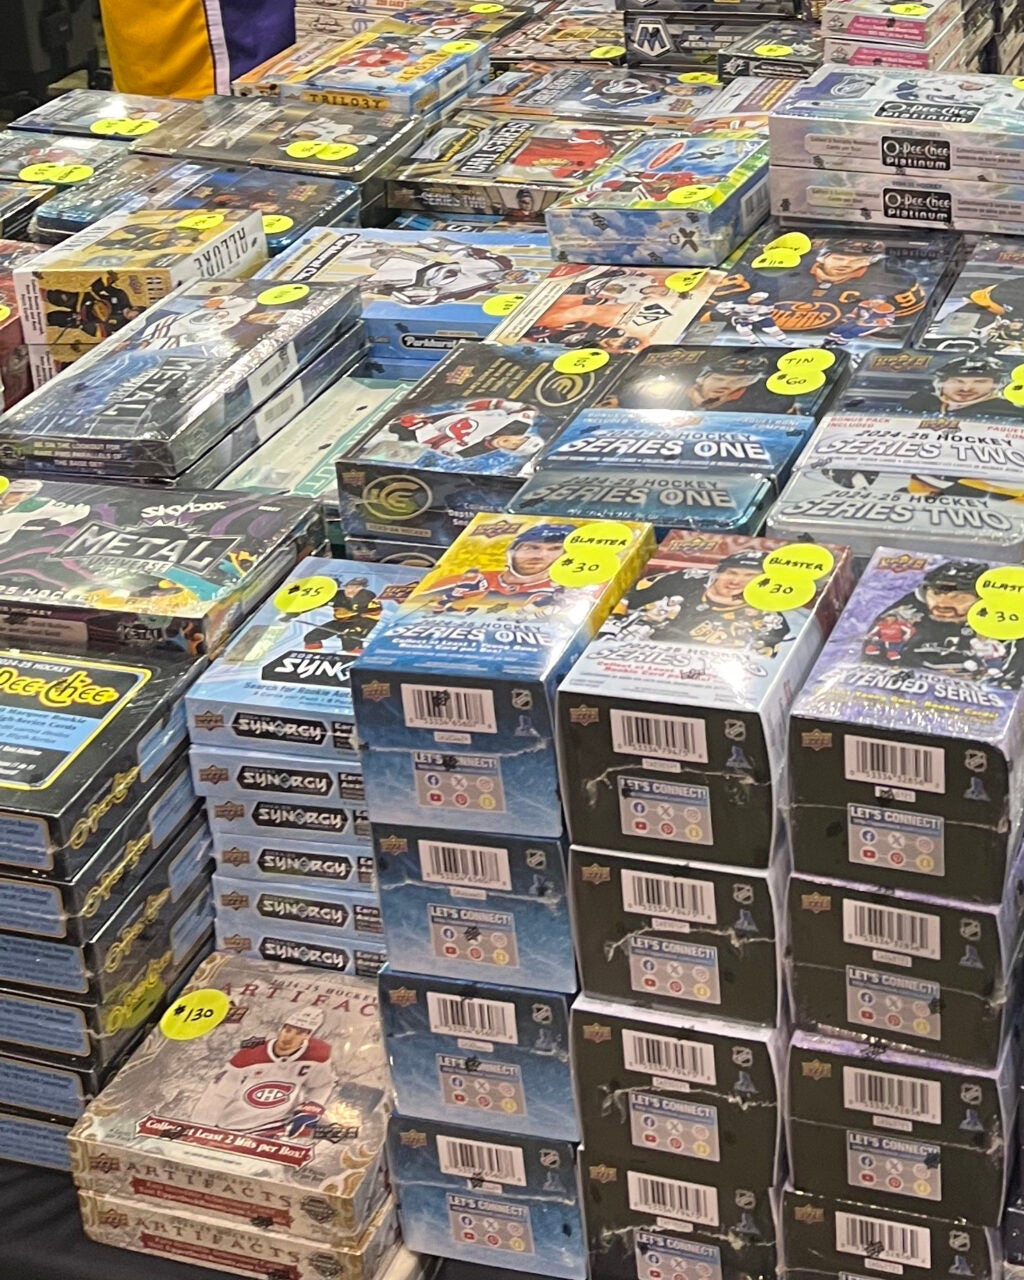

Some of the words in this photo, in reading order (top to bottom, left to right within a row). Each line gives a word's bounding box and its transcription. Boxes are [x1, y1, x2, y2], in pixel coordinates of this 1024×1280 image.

[883, 139, 950, 158] O-Pee-Chee
[885, 158, 947, 169] Platinum
[885, 191, 951, 210] O-Pee-Chee
[888, 208, 948, 220] Platinum
[785, 355, 815, 366] TIN
[777, 373, 807, 386] $60
[856, 429, 930, 442] 2024-25
[937, 433, 1014, 447] HOCKEY
[988, 426, 1022, 434] PAQUET
[562, 435, 682, 457] SERIES
[693, 440, 767, 460] ONE
[817, 438, 941, 460] SERIES
[639, 478, 719, 490] HOCKEY
[526, 484, 649, 504] SERIES
[659, 489, 736, 508] ONE
[825, 490, 901, 503] 2024-25
[909, 495, 989, 509] HOCKEY
[784, 498, 922, 522] SERIES
[930, 508, 1013, 532] TWO
[64, 523, 216, 568] METAL
[570, 535, 627, 547] BLASTER
[562, 558, 600, 573] $30
[769, 556, 823, 571] BLASTER
[288, 584, 322, 598] $85
[757, 578, 793, 595] $30
[976, 608, 1019, 622] $30
[391, 623, 488, 640] SERIES
[494, 630, 554, 645] ONE
[587, 649, 690, 667] SERIES
[935, 682, 1001, 707] SERIES
[653, 782, 706, 798] CONNECT!
[851, 806, 880, 819] LET'S
[884, 810, 942, 829] CONNECT!
[430, 906, 459, 919] LET'S
[460, 909, 511, 925] CONNECT!
[631, 937, 659, 950] LET'S
[660, 942, 715, 959] CONNECT!
[220, 981, 376, 1017] ARTIFAC
[173, 1005, 214, 1023] $130
